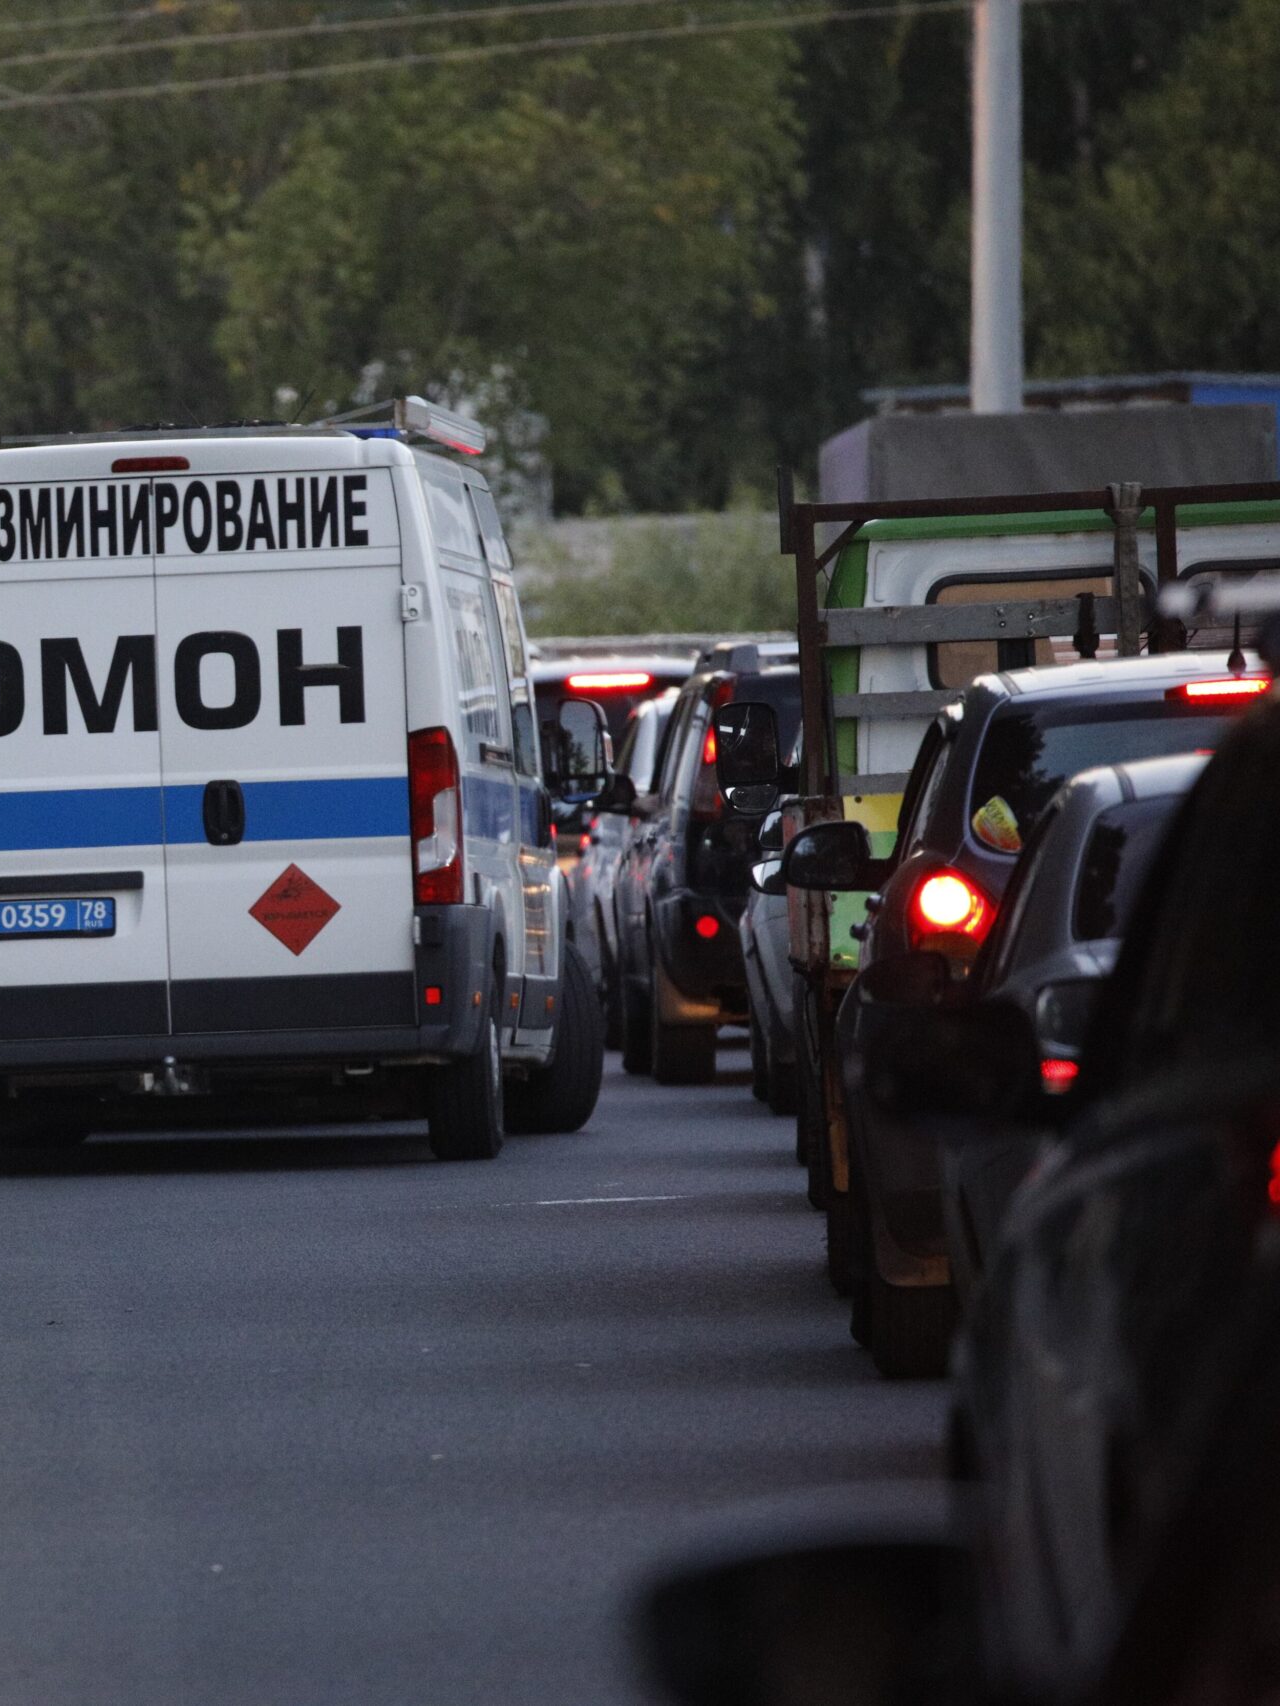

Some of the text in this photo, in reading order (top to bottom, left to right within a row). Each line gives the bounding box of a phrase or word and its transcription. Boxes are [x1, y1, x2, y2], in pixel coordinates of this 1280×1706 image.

[1, 904, 66, 929] 0359
[81, 901, 106, 920] 78
[84, 920, 103, 928] RUS
